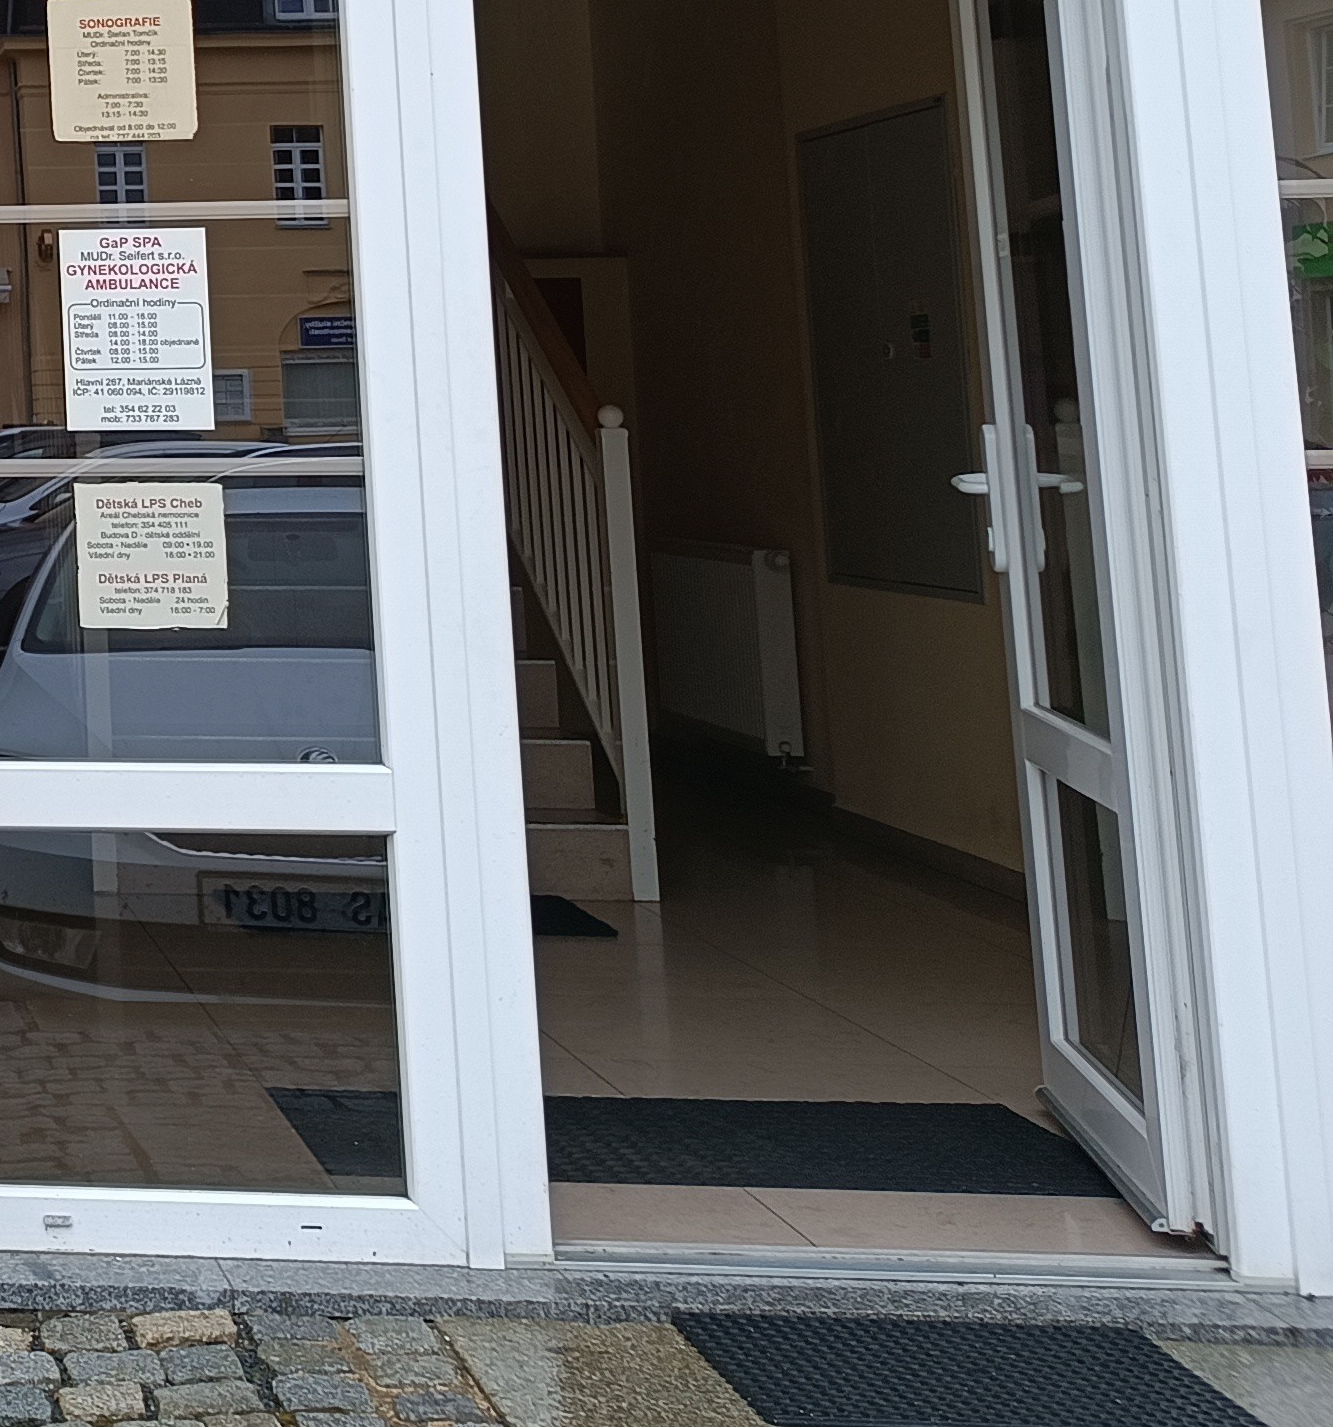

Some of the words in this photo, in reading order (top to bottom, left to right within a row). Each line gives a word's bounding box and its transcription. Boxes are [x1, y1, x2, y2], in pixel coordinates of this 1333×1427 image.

[79, 17, 160, 29] SONOGRAFIE
[99, 237, 128, 249] GaP
[133, 237, 161, 248] SPA
[80, 251, 115, 261] MUDr.
[119, 251, 155, 261] Seifert
[158, 251, 185, 260] s.r.o.
[66, 260, 197, 276] GYNEKOLOGICKÁ
[85, 278, 180, 290] AMBULANCE
[90, 299, 139, 308] Ordinační
[143, 298, 176, 309] hodiny
[74, 321, 93, 331] Úterý
[74, 330, 98, 338] Středa
[75, 347, 101, 356] Čtvrtek
[76, 356, 97, 364] Pátek
[76, 378, 103, 387] Hlavní
[127, 378, 172, 386] Mariánské
[175, 377, 201, 386] Lázně
[73, 387, 91, 396] IČP:
[94, 388, 104, 396] 41
[147, 386, 160, 396] IČ:
[119, 405, 135, 413] 354
[139, 405, 149, 413] 62
[152, 405, 162, 413] 22
[165, 405, 176, 413] 03
[96, 499, 138, 509] Dětská
[142, 499, 166, 509] LPS
[170, 498, 202, 508] Cheb
[88, 551, 115, 559] Všední
[117, 552, 130, 560] dny
[98, 573, 140, 584] Dětská
[144, 574, 169, 583] LPS
[173, 573, 207, 583] Planá
[100, 606, 126, 614] Všední
[128, 607, 142, 615] dny
